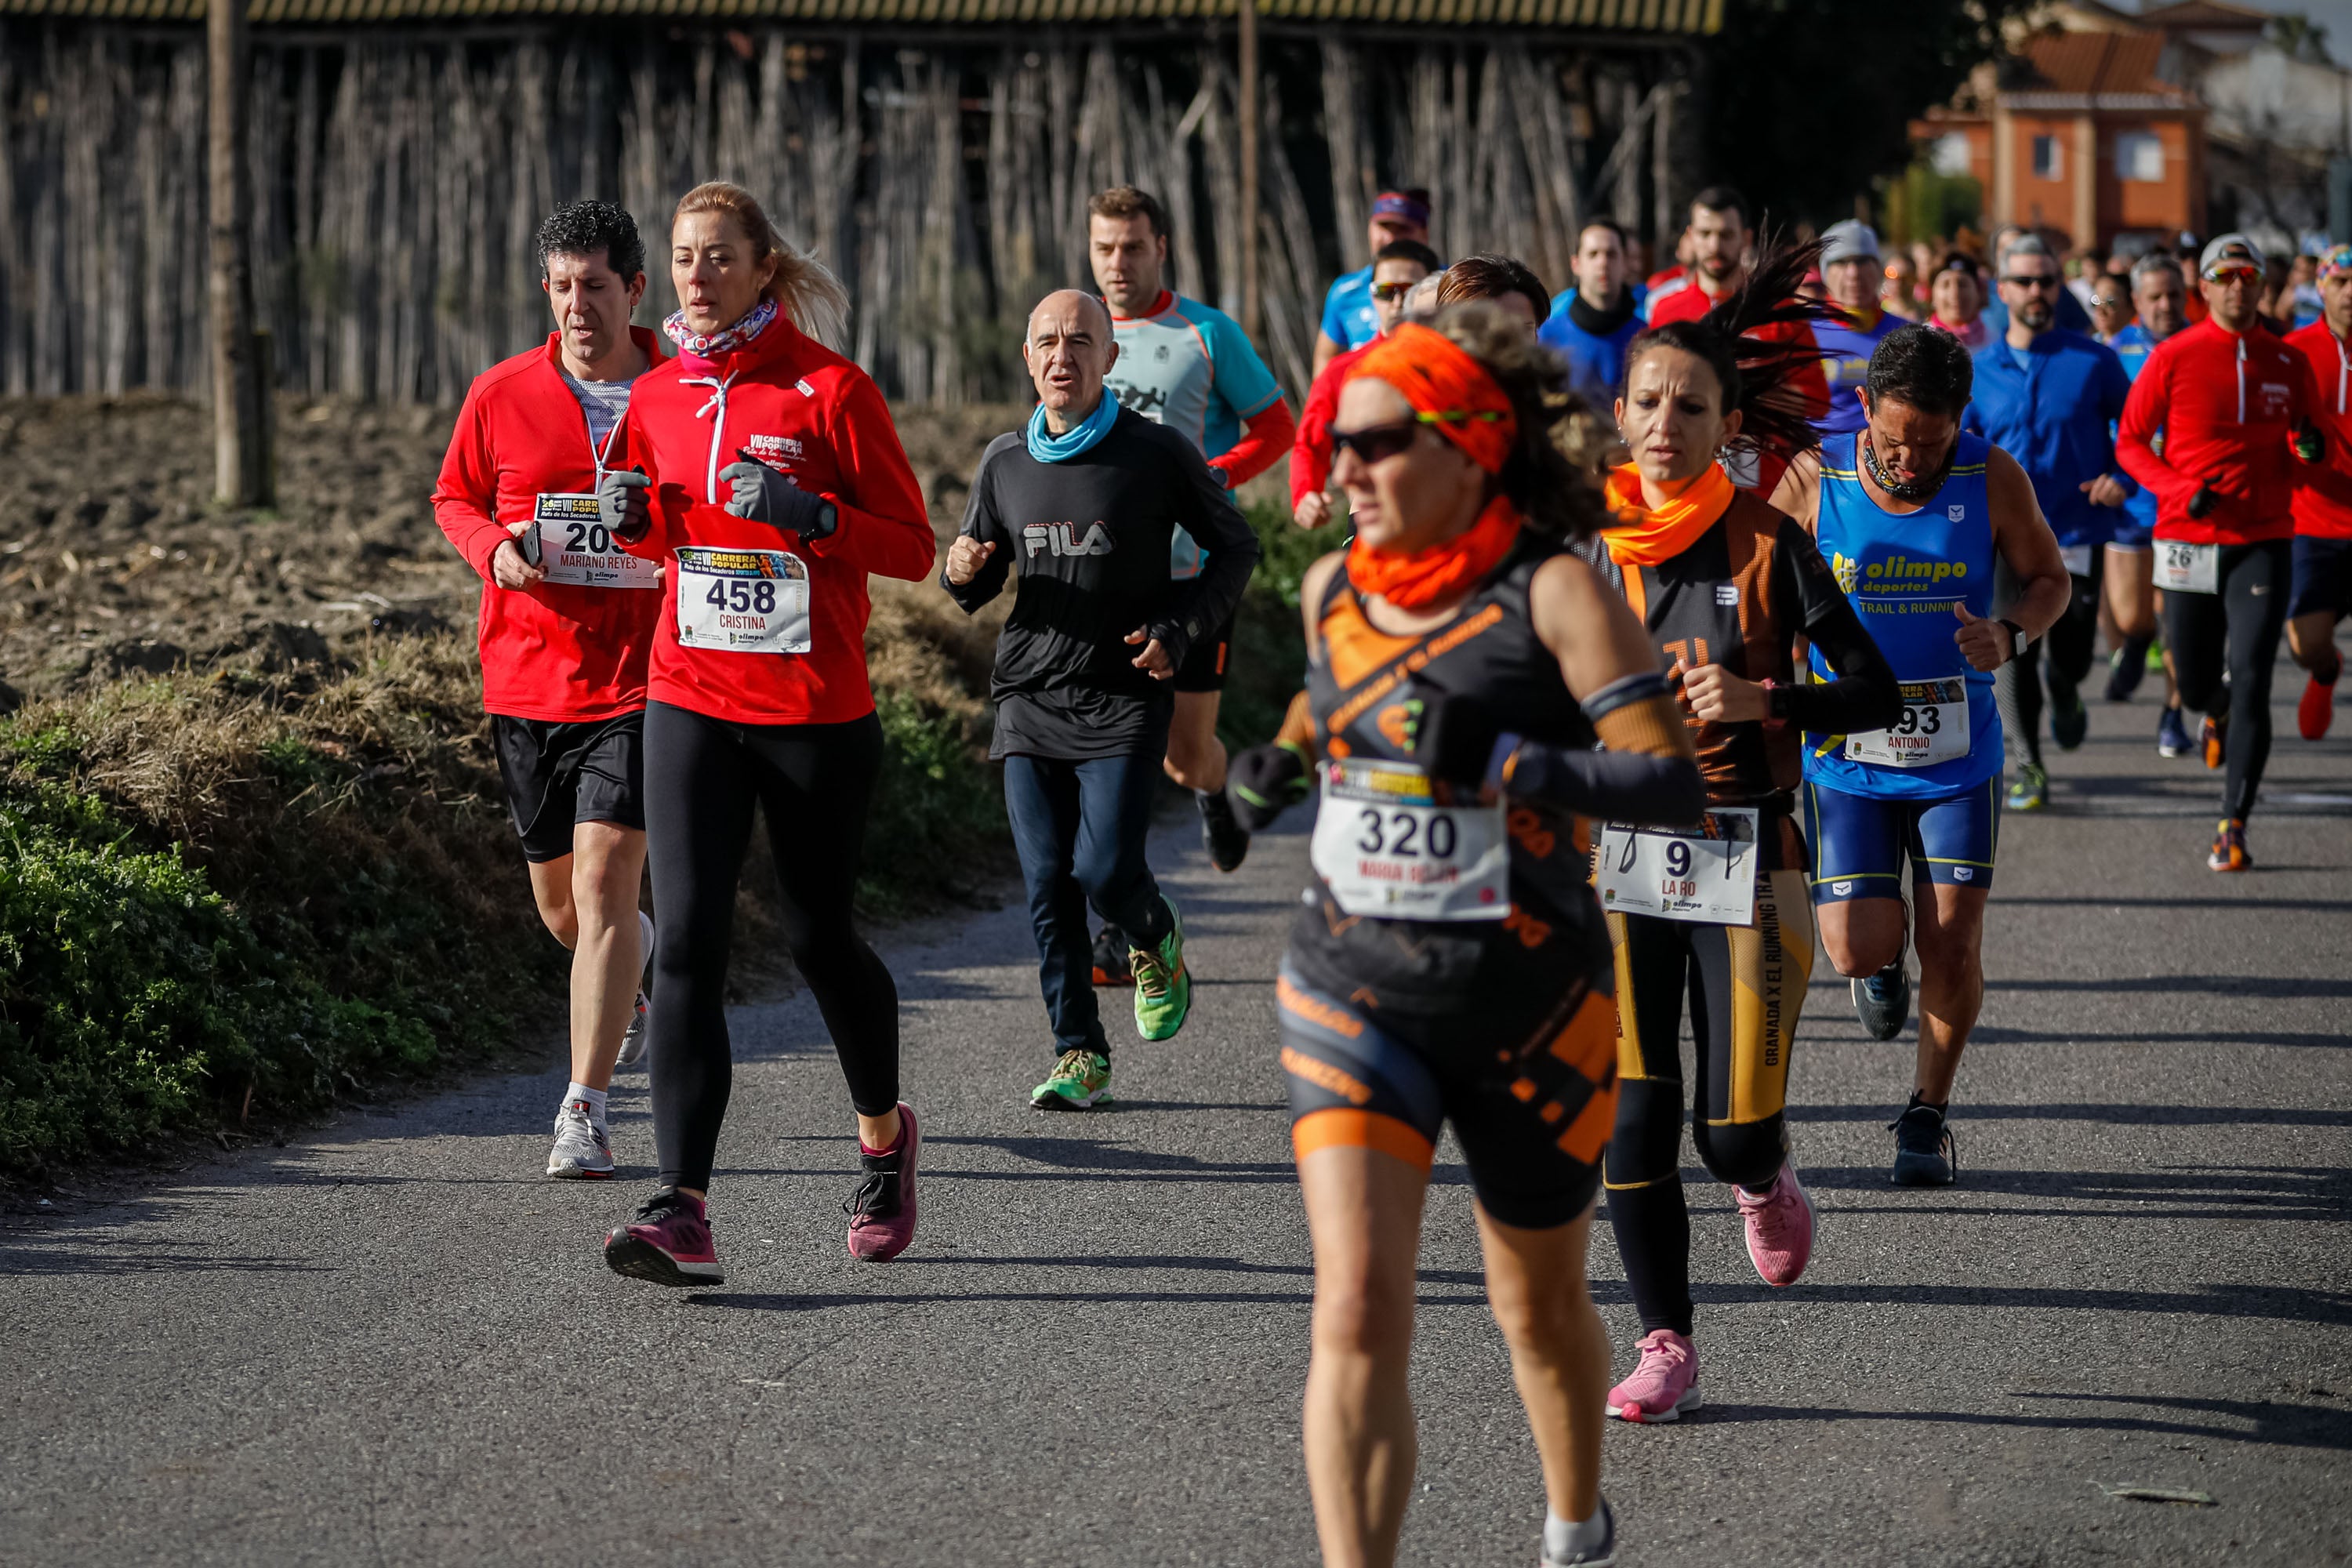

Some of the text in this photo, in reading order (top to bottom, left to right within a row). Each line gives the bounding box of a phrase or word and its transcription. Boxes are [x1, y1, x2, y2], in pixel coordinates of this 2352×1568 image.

[750, 434, 763, 448] VII
[761, 442, 802, 454] POPULAR
[764, 436, 802, 448] CARRERA
[765, 459, 790, 469] olimpo
[1023, 521, 1112, 558] FILA
[560, 554, 637, 569] MARIANO REYES
[711, 552, 757, 563] CARRERA
[684, 562, 695, 571] Ruta
[710, 566, 735, 575] Secaderos
[711, 561, 757, 569] POPULAR
[1866, 556, 1967, 583] olimpo
[1863, 581, 1928, 593] deportes
[706, 579, 776, 614] 458
[1860, 600, 1965, 614] TRAIL & RUNNIN
[720, 615, 766, 630] CRISTINA
[739, 632, 764, 641] olimpo
[1886, 706, 1940, 735] 93
[1888, 736, 1930, 749] ANTONIO
[1359, 808, 1457, 859] 320
[1666, 840, 1691, 877] 9
[1662, 880, 1696, 897] LA RO
[1673, 899, 1702, 909] olimpo
[1759, 903, 1782, 963] RUNNING
[1766, 966, 1782, 983] EL
[1765, 1000, 1780, 1066] GRANADA
